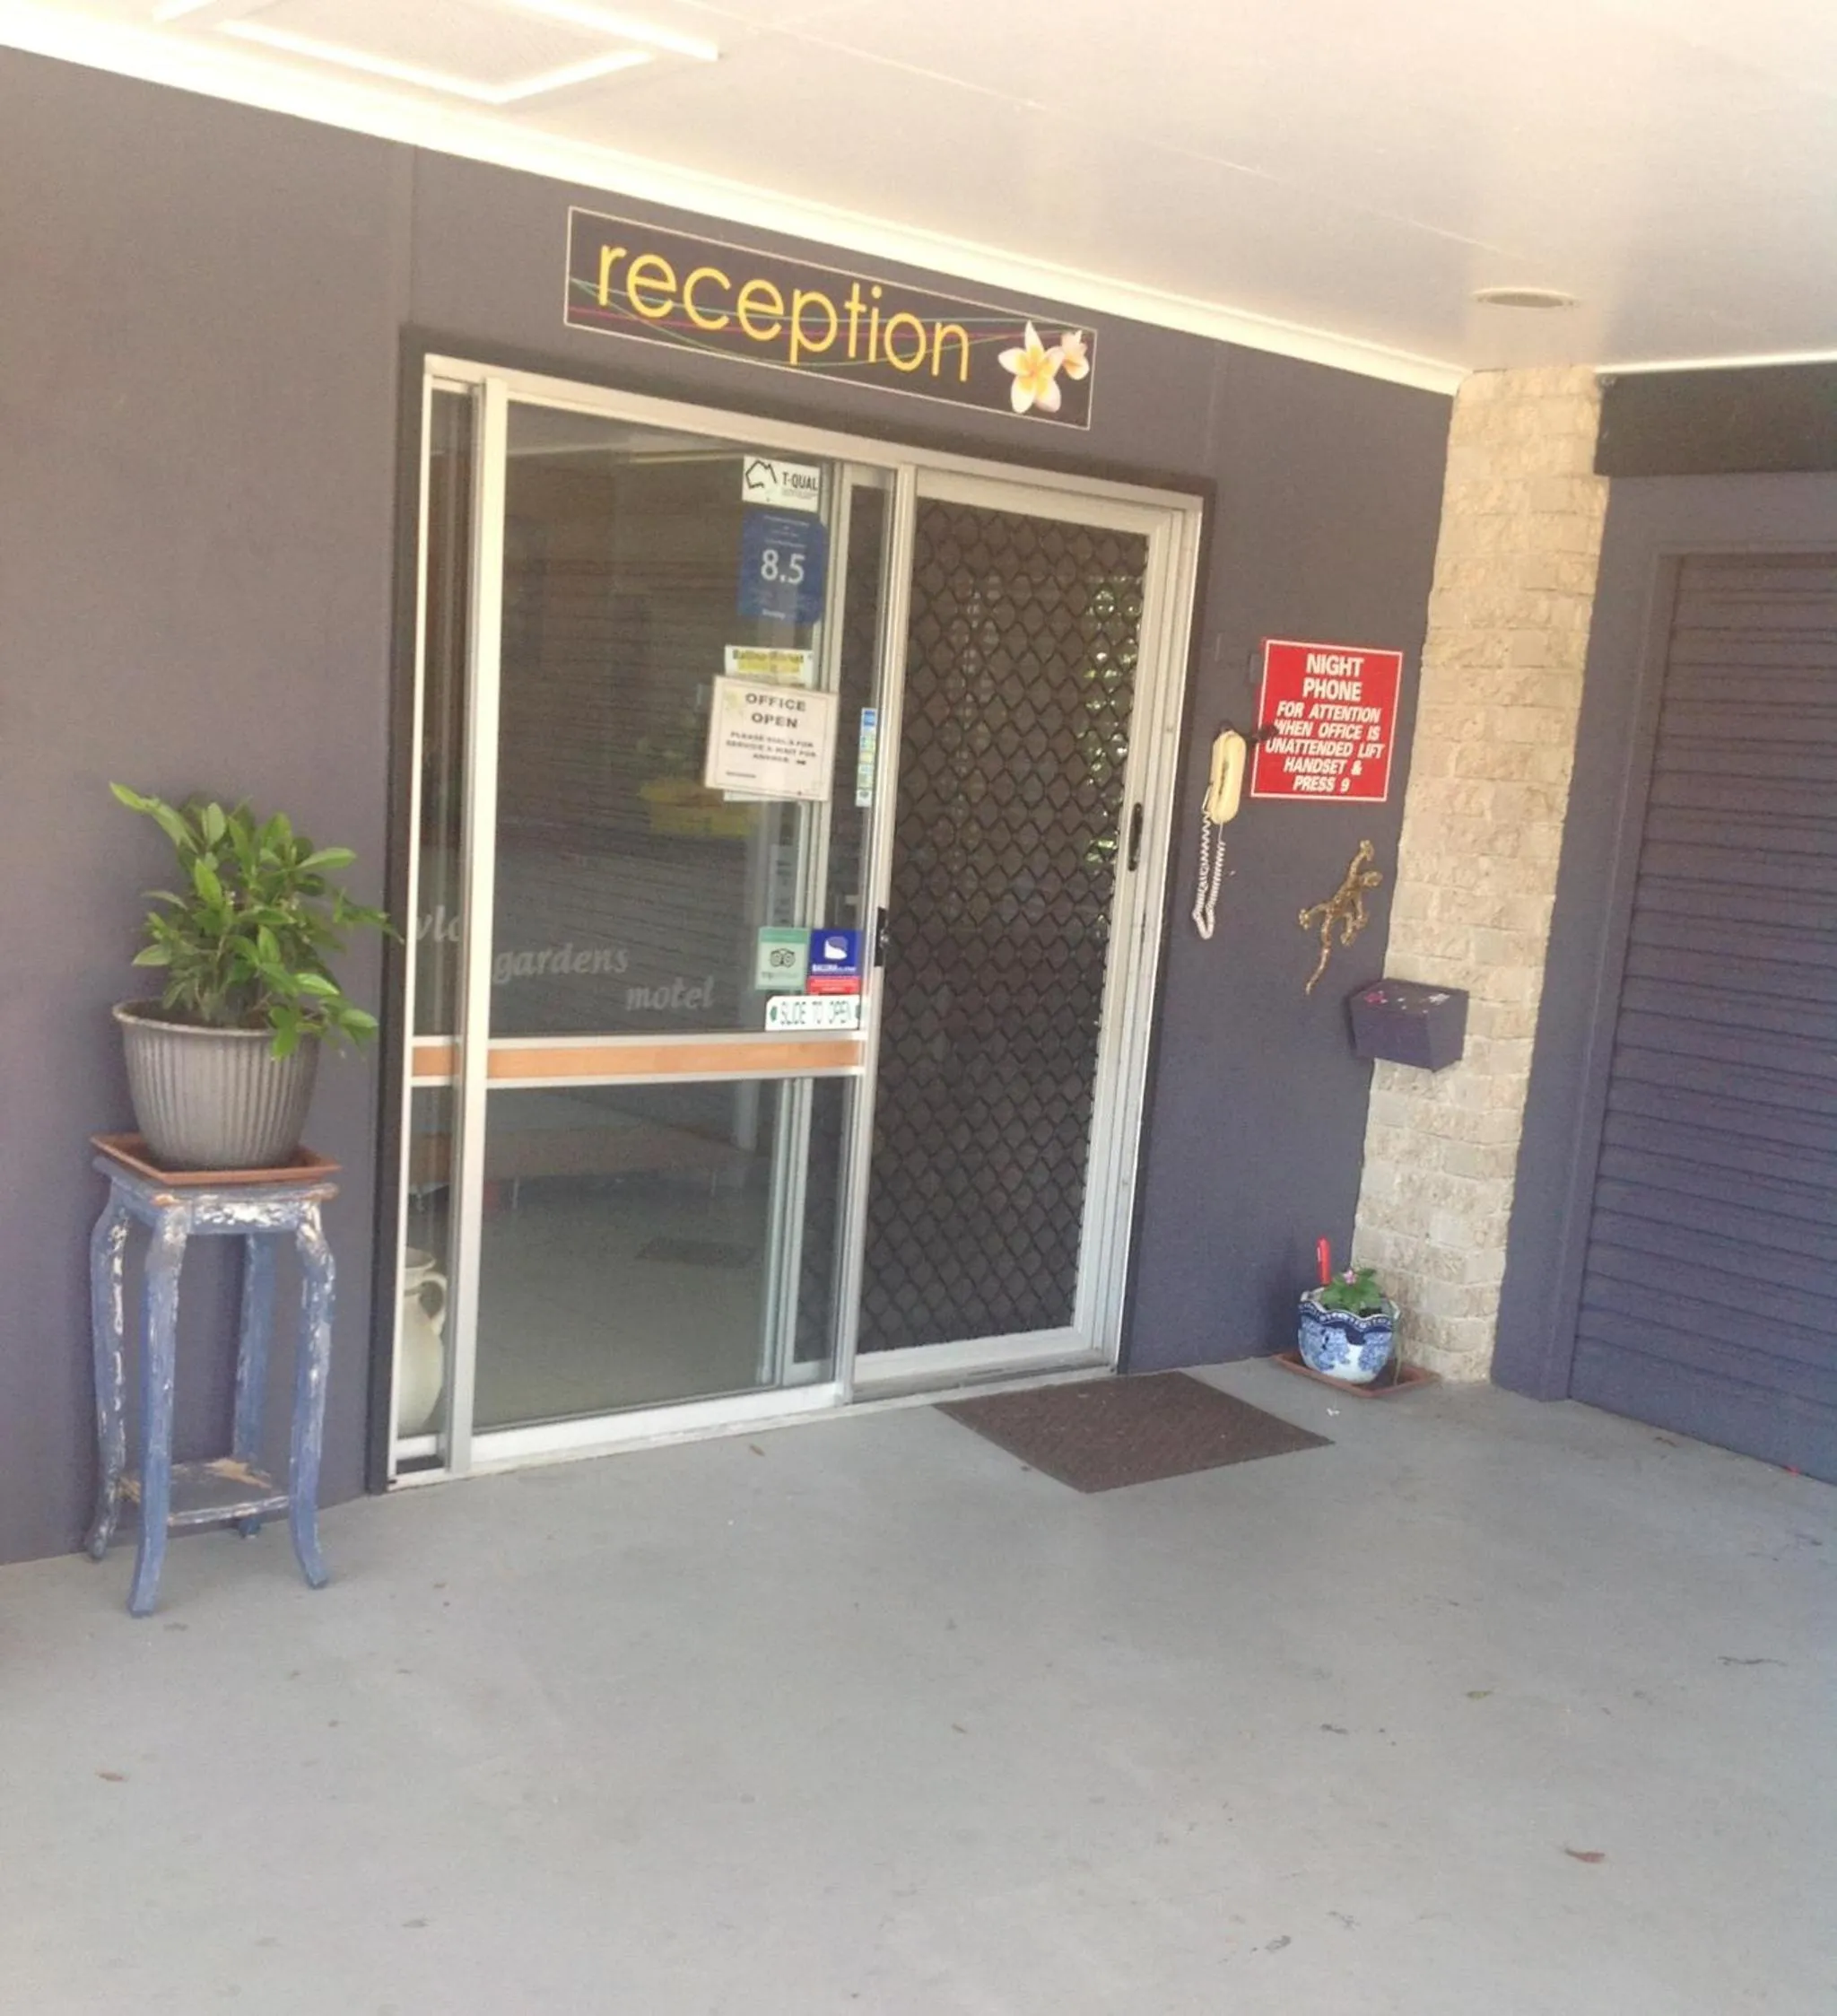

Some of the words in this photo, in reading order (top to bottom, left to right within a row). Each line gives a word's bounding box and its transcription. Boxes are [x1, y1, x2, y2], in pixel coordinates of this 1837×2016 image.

[598, 245, 970, 381] reception
[782, 472, 818, 491] T-QUAL
[761, 549, 805, 584] 8.5
[1306, 653, 1364, 676] NIGHT
[1302, 677, 1363, 702] PHONE
[745, 693, 806, 711] OFFICE
[1277, 701, 1304, 717] FOR
[1309, 703, 1381, 722] ATTENTION
[752, 712, 797, 729] OPEN
[1274, 719, 1312, 737] WHEN
[1319, 722, 1363, 739] OFFICE
[1367, 726, 1380, 740] IS
[1266, 737, 1354, 757] UNATTENDED
[1358, 743, 1386, 759] LIFT
[1284, 757, 1347, 774] HANDSET
[1351, 760, 1363, 775] &
[1293, 775, 1335, 792] PRESS
[1340, 777, 1350, 792] 9
[493, 942, 628, 984] gardens
[627, 975, 714, 1011] motel
